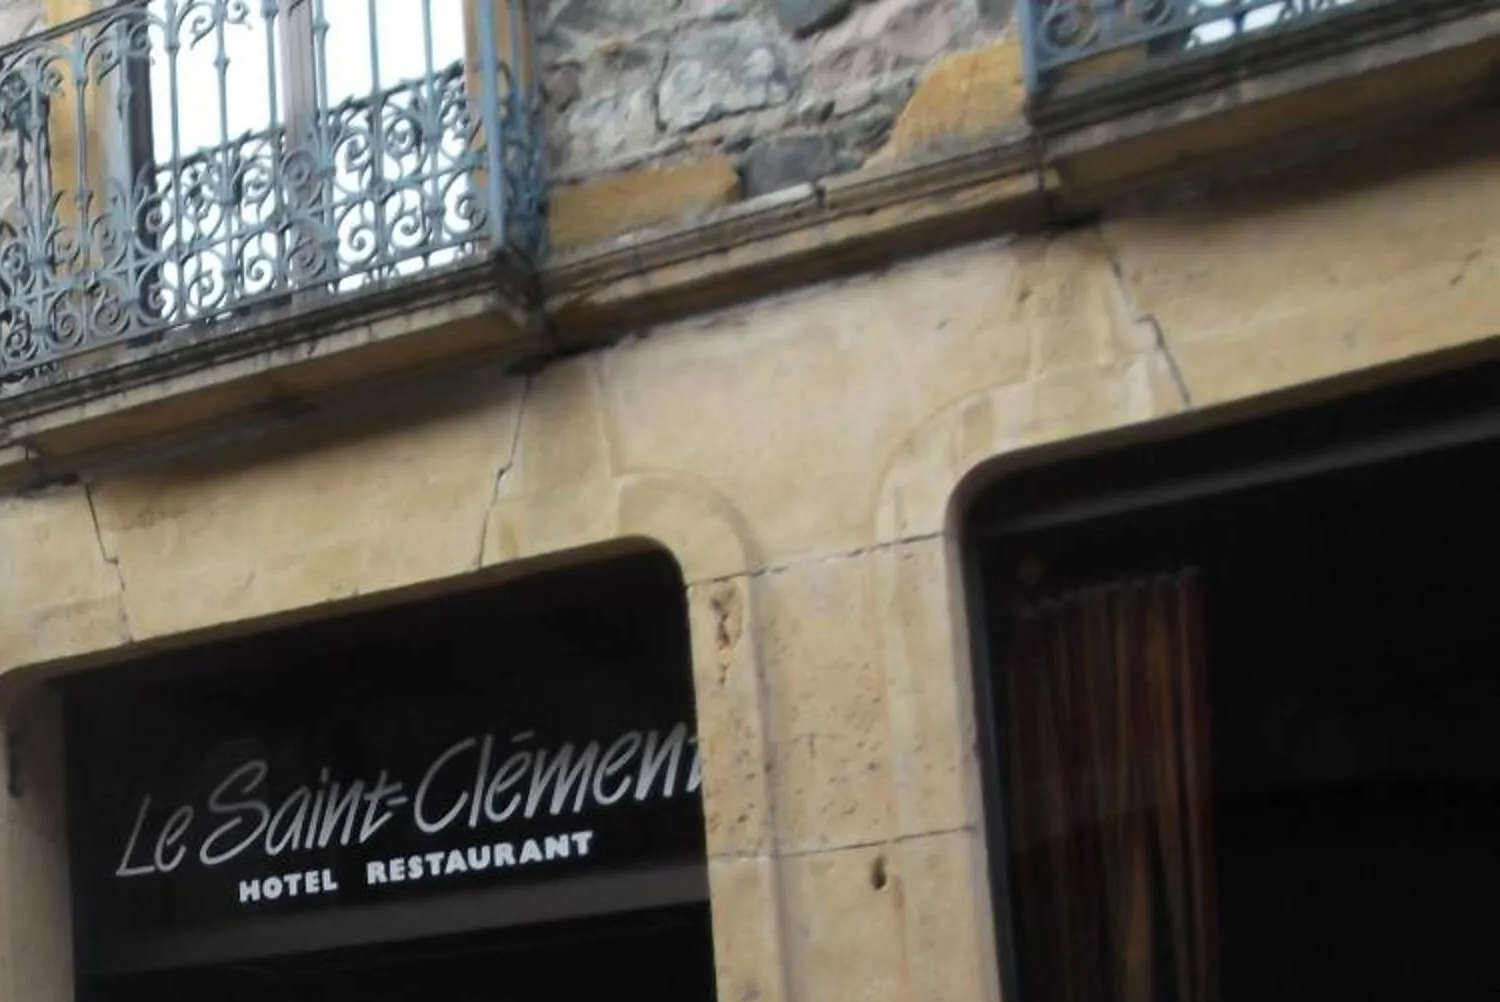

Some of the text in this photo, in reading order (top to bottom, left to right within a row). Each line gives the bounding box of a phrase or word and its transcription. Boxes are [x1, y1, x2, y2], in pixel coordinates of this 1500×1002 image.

[116, 794, 195, 877] Le
[239, 830, 594, 904] HOTEL RESTAURANT
